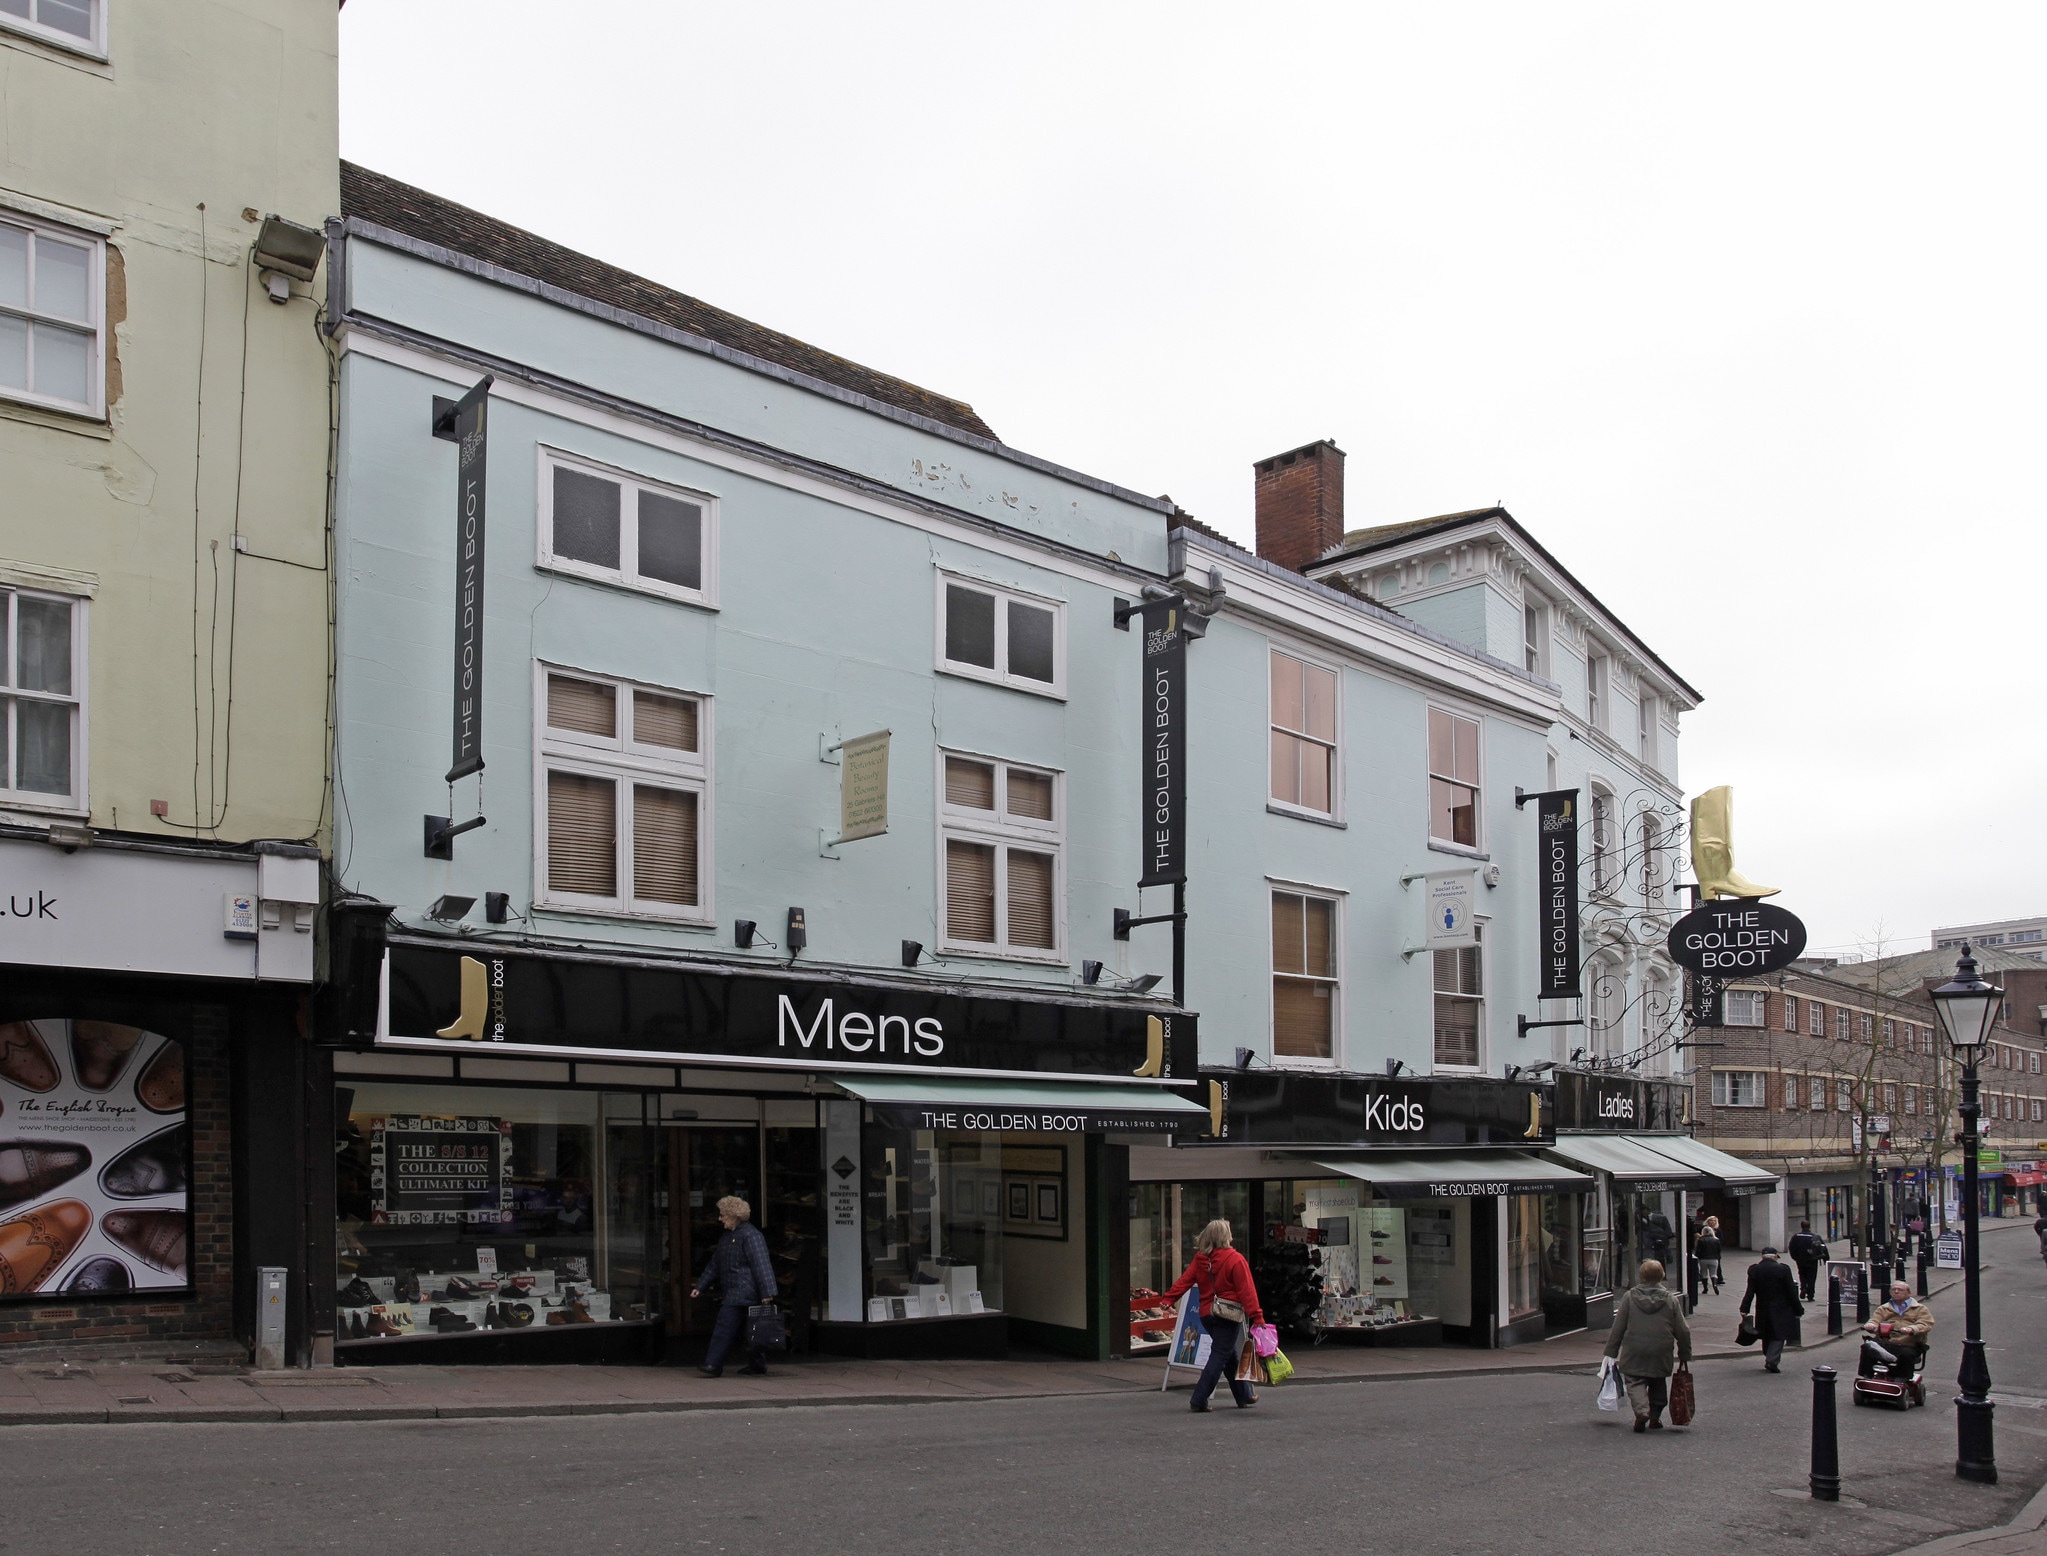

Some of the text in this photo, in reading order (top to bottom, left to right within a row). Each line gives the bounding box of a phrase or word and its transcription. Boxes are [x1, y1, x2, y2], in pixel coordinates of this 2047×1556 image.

[462, 431, 473, 446] THE
[462, 432, 484, 457] GOLDEN
[461, 448, 477, 467] BOOT
[465, 479, 477, 561] BOOT
[463, 564, 475, 690] GOLDEN
[1147, 629, 1162, 640] THE
[1147, 631, 1178, 648] GOLDEN
[1147, 642, 1168, 655] BOOT
[1156, 668, 1169, 728] BOOT
[461, 697, 472, 758] THE
[1156, 733, 1169, 824] GOLDEN
[1544, 817, 1573, 826] GOLDEN
[1544, 823, 1563, 831] BOOT
[1156, 828, 1169, 873] THE
[1552, 838, 1565, 884] BOOT
[1553, 886, 1566, 953] GOLDEN
[1712, 911, 1759, 929] THE
[1686, 929, 1788, 950] GOLDEN
[1702, 950, 1770, 968] BOOT
[1554, 957, 1566, 988] THE
[778, 994, 944, 1056] Mens
[18, 1099, 138, 1117] The English Brogue
[1365, 1094, 1424, 1131] Kids
[1599, 1090, 1634, 1119] Ladies
[18, 1124, 136, 1132] www.thegoldenboot.co.uk
[921, 1112, 957, 1129] THE
[963, 1113, 1037, 1130] GOLDEN
[1042, 1116, 1088, 1131] BOOT
[1098, 1120, 1155, 1128] ESTABLISHED
[398, 1145, 489, 1159] THE S/S 12
[399, 1162, 488, 1173] COLLECTION
[399, 1179, 489, 1190] ULTIMATE KIT
[1429, 1184, 1448, 1196] THE
[1449, 1184, 1486, 1196] GOLDEN
[1487, 1183, 1509, 1195] BOOT
[479, 1256, 495, 1264] 70%
